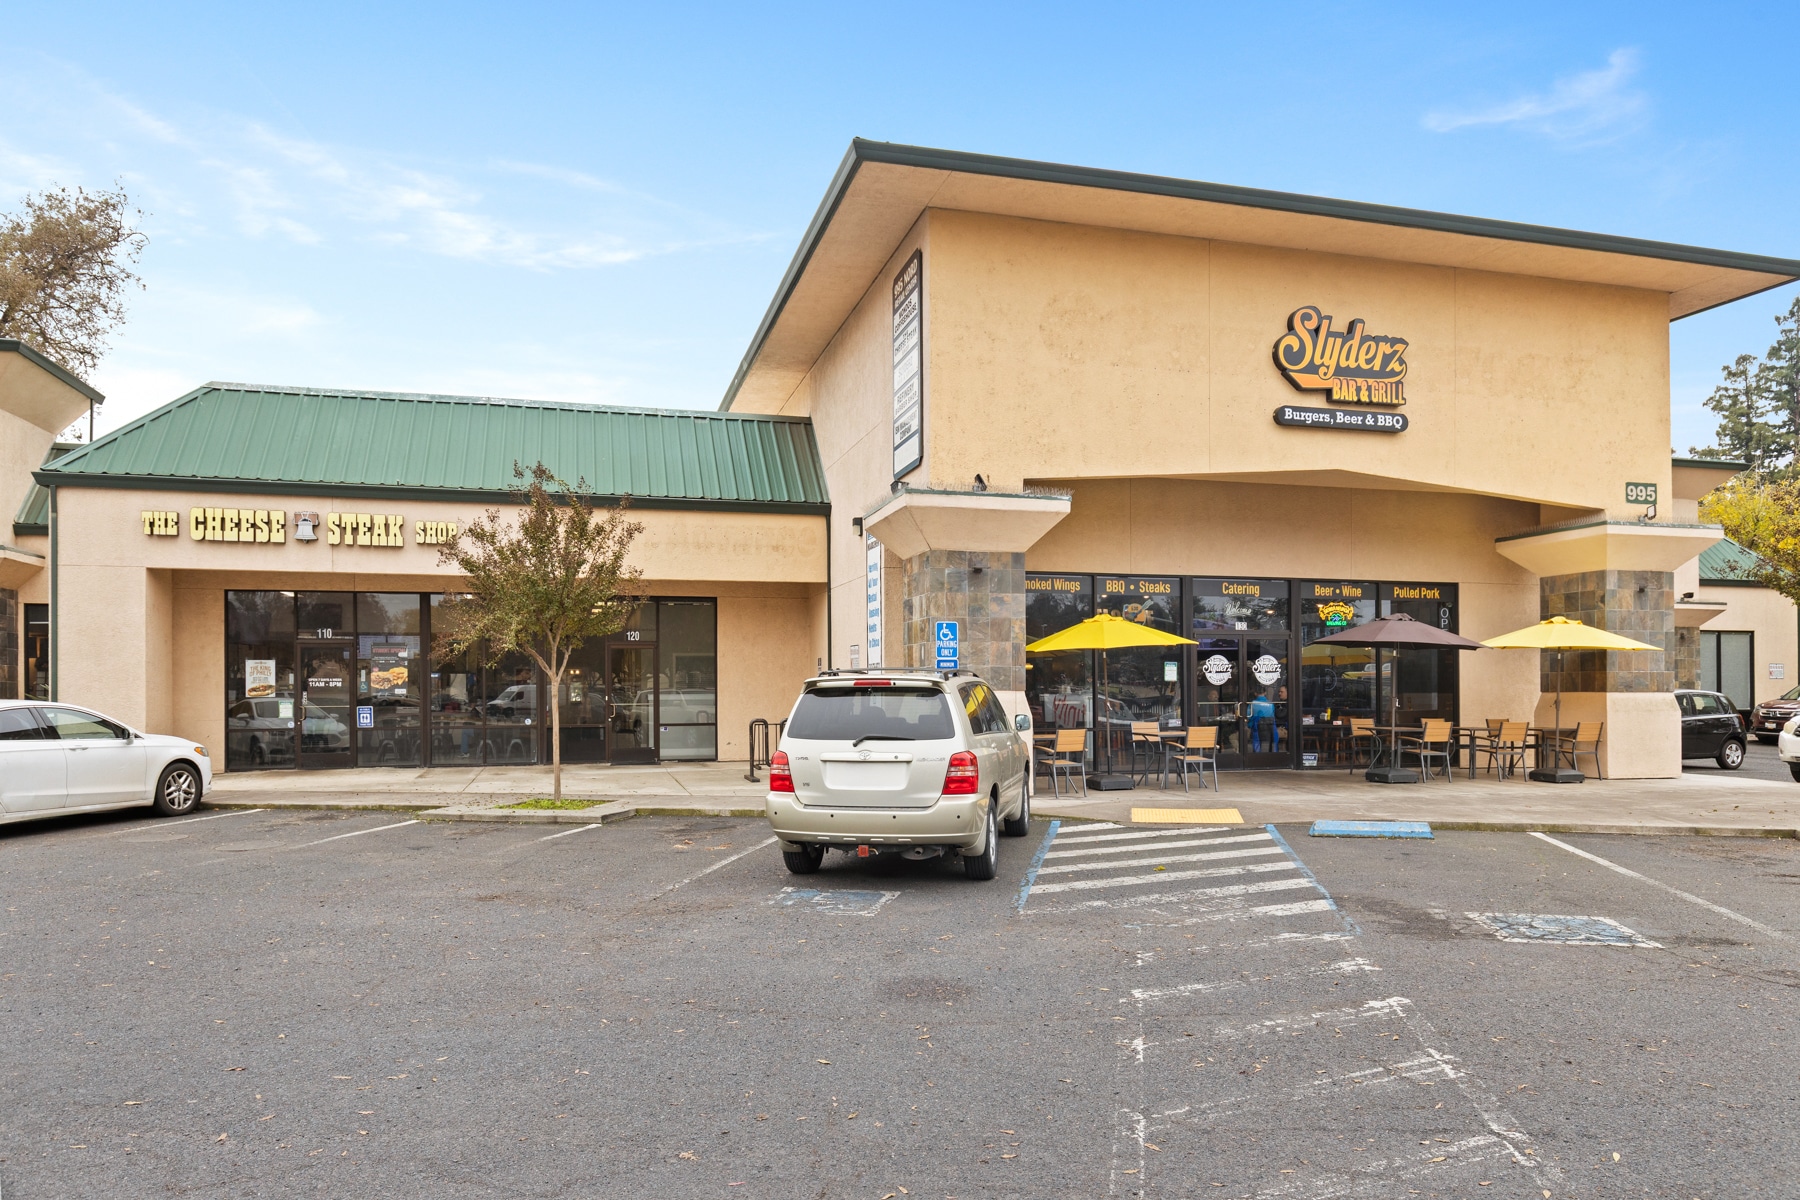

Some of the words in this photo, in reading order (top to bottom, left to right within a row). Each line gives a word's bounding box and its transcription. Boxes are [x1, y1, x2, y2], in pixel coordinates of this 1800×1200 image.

[894, 278, 903, 298] 995
[903, 258, 918, 286] NORD
[1278, 308, 1408, 379] Slyderz
[1333, 378, 1358, 400] BAR
[1360, 380, 1370, 402] &
[1371, 381, 1406, 404] GRILL
[1284, 408, 1334, 424] Burgers,
[1336, 412, 1362, 424] Beer
[1365, 414, 1375, 425] &
[1377, 415, 1403, 428] BBQ
[1627, 485, 1656, 502] 995
[141, 510, 180, 536] THE
[190, 507, 287, 544] CHEESE
[327, 512, 404, 548] STEAK
[415, 520, 458, 544] SHOP
[1054, 579, 1080, 593] Wings
[1106, 580, 1125, 594] BBQ
[1139, 580, 1171, 594] Steaks
[1222, 582, 1260, 597] Catering
[1314, 584, 1333, 597] Beer
[1342, 585, 1362, 597] Wine
[1394, 587, 1419, 598] Pulled
[1421, 588, 1440, 599] Pork
[1224, 602, 1251, 615] Welcome
[317, 628, 332, 639] 110
[627, 631, 639, 640] 120
[1203, 658, 1232, 673] Slyderz
[1252, 658, 1281, 673] Slyderz
